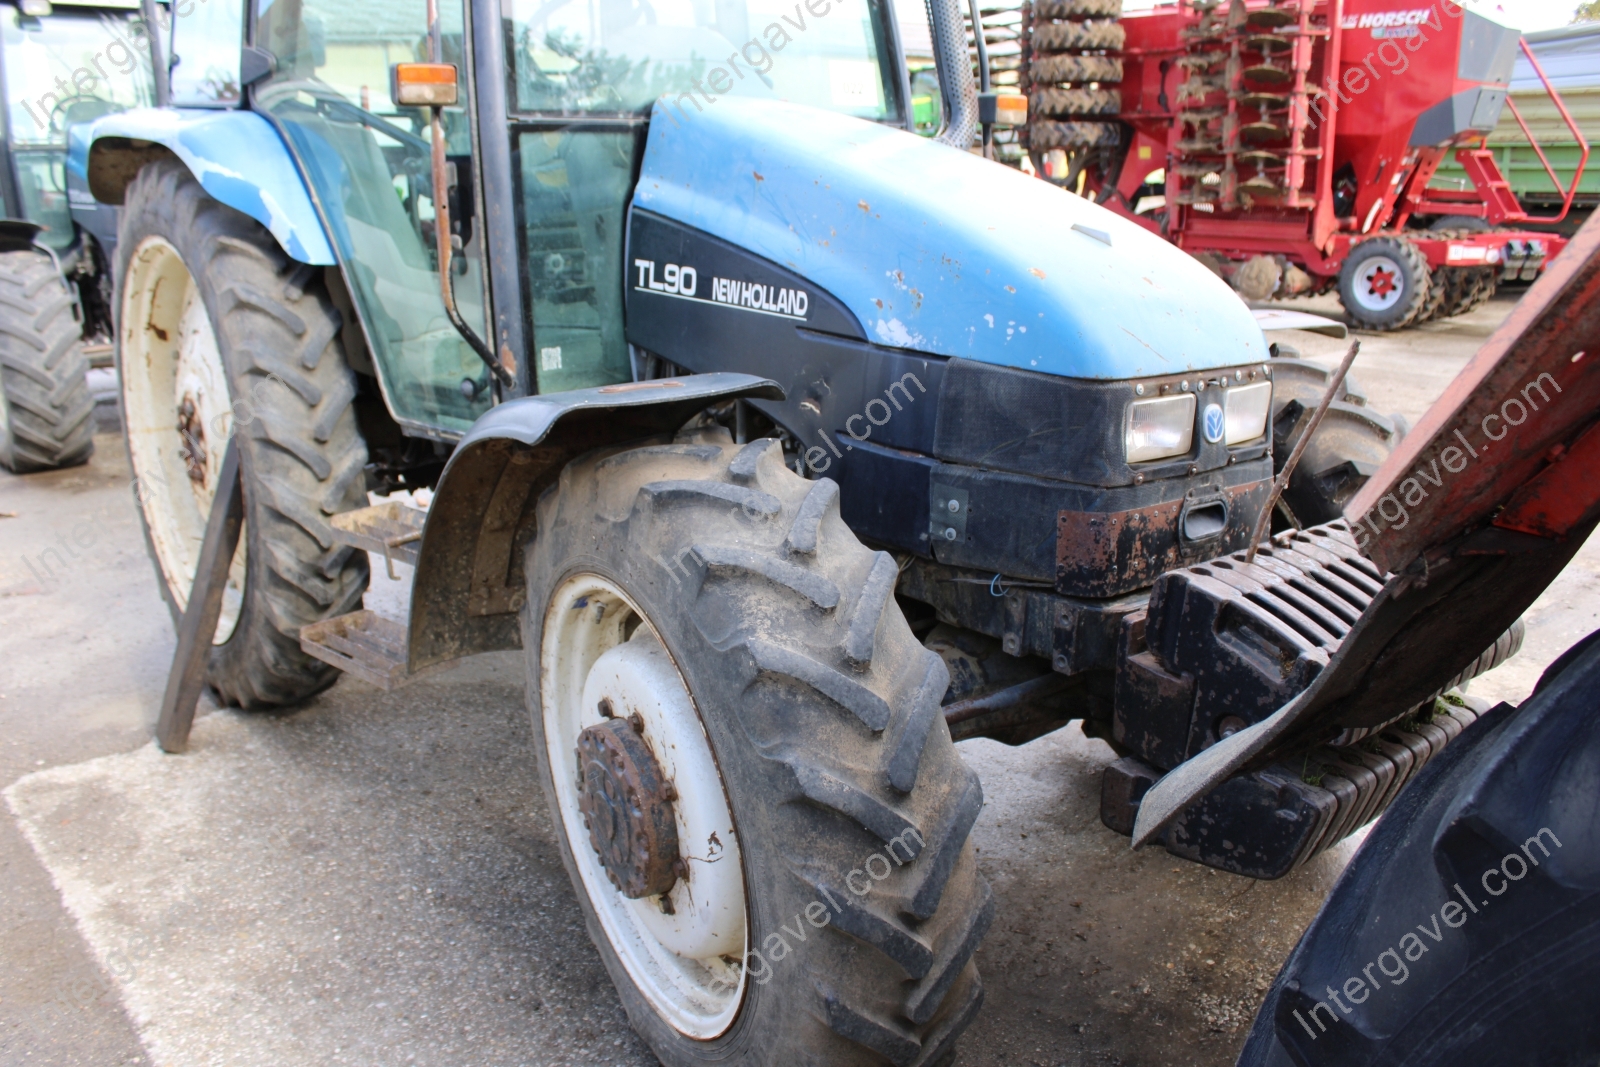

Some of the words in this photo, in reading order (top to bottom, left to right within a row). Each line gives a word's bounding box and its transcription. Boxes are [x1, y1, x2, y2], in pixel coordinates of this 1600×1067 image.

[1358, 8, 1431, 29] HORSCH
[634, 258, 697, 297] TL90
[712, 276, 741, 304] NEW
[740, 281, 808, 317] HOLLAND
